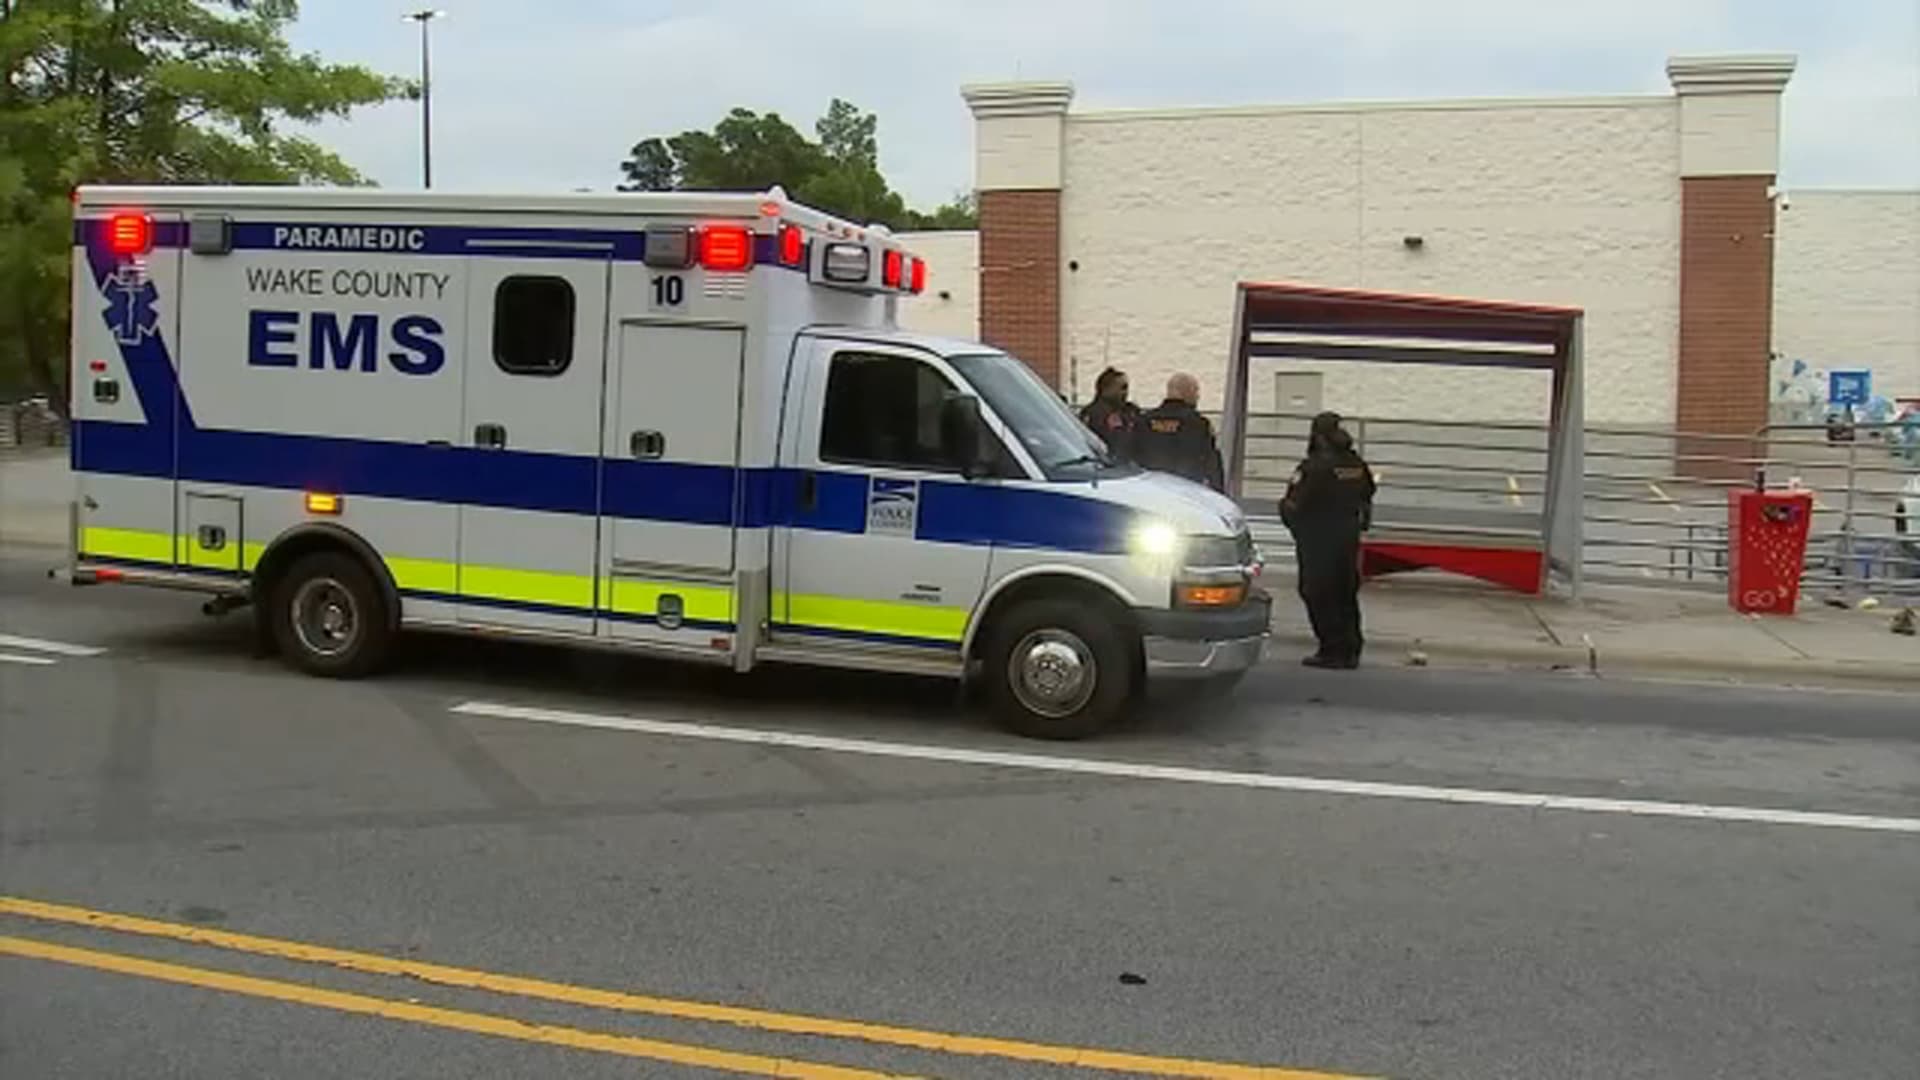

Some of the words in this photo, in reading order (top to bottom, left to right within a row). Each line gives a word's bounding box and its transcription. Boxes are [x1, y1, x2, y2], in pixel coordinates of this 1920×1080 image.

[274, 227, 425, 250] PARAMEDIC
[246, 267, 325, 295] WAKE
[332, 269, 450, 299] COUNTY
[651, 274, 684, 307] 10
[248, 309, 446, 376] EMS
[1743, 590, 1777, 608] GO
